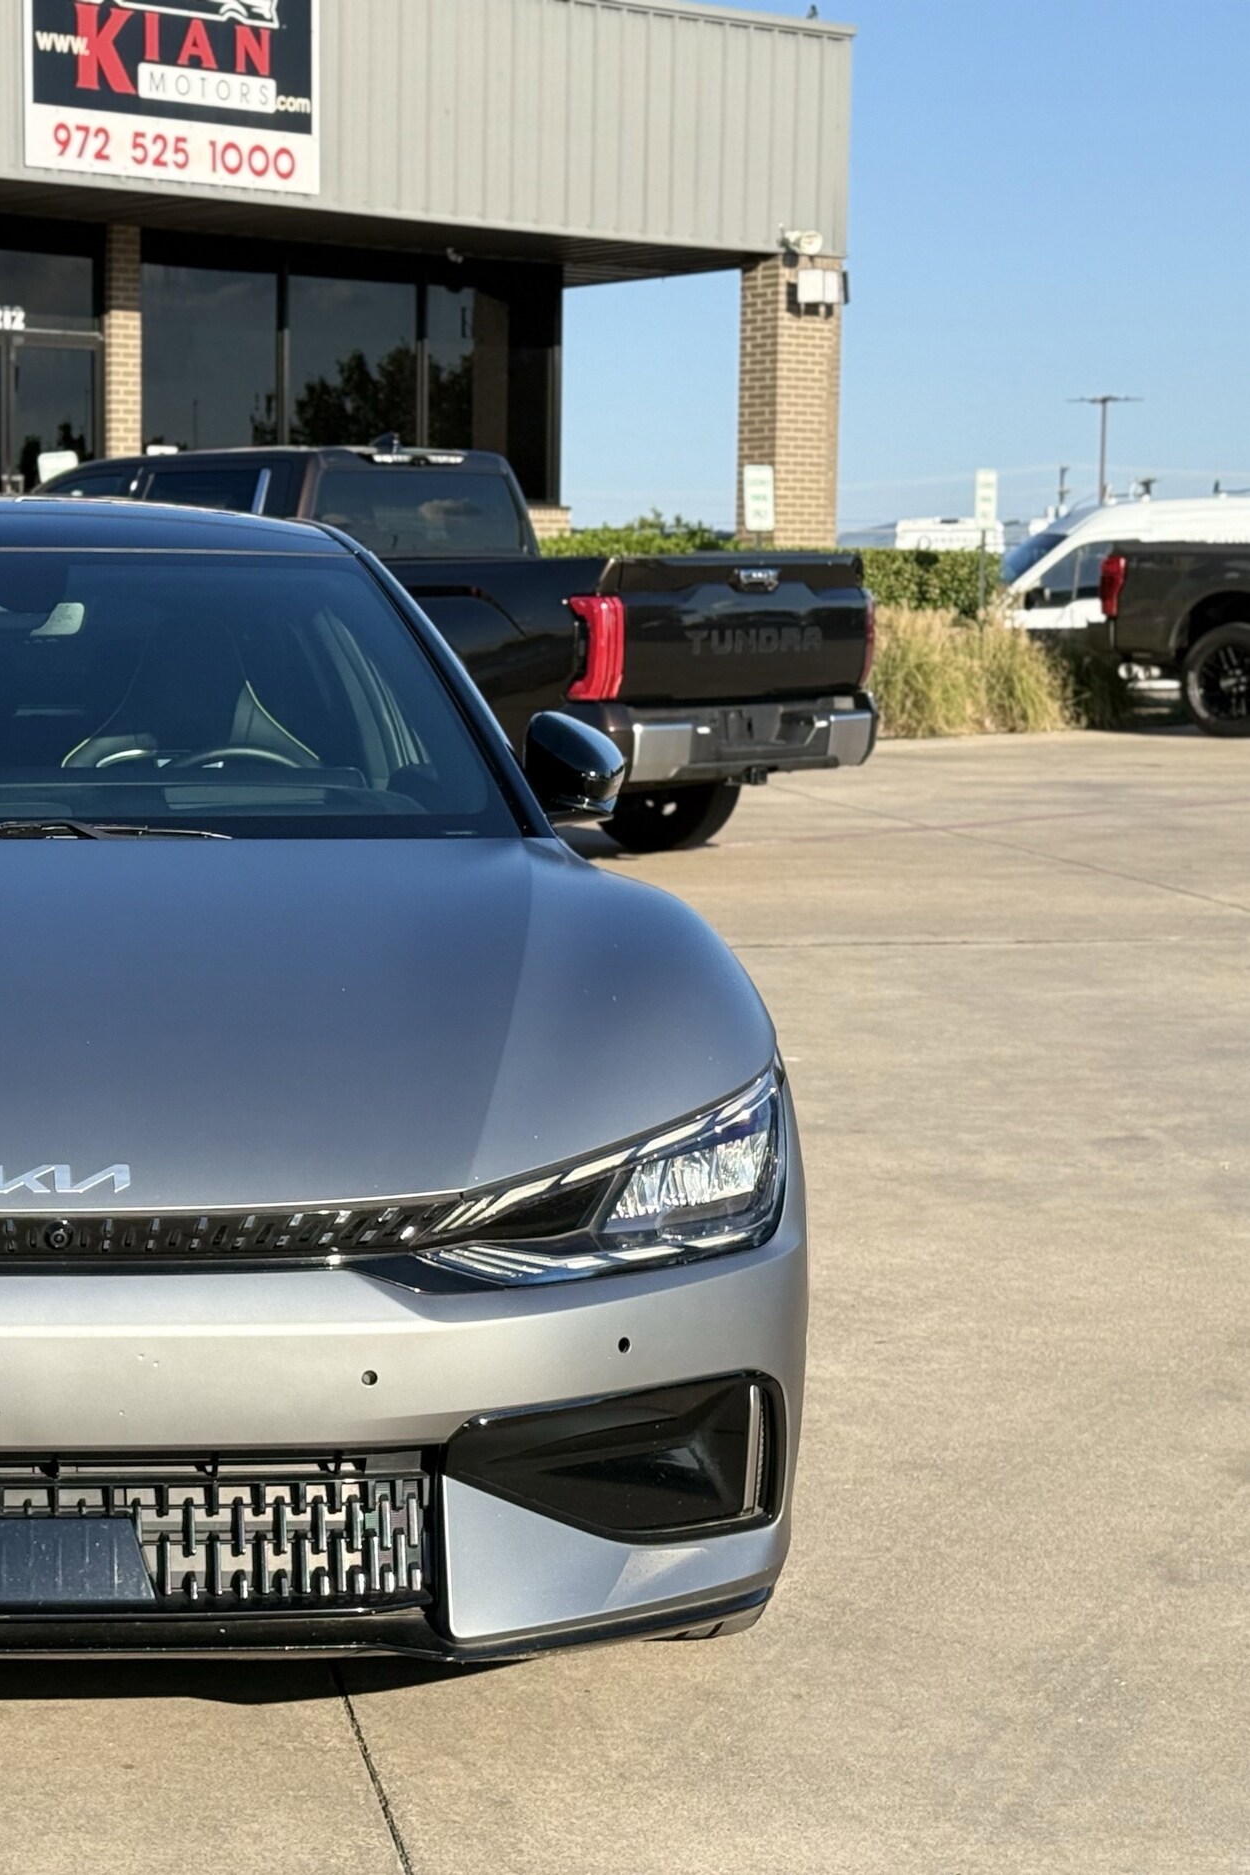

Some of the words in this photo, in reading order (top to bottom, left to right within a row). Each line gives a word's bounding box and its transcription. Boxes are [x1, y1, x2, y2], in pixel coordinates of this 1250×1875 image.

[75, 2, 271, 95] KIAN
[148, 71, 270, 106] MOTORS
[53, 122, 111, 161] 972
[131, 131, 190, 170] 525
[209, 140, 295, 180] 1000
[685, 626, 823, 656] TUNDRA
